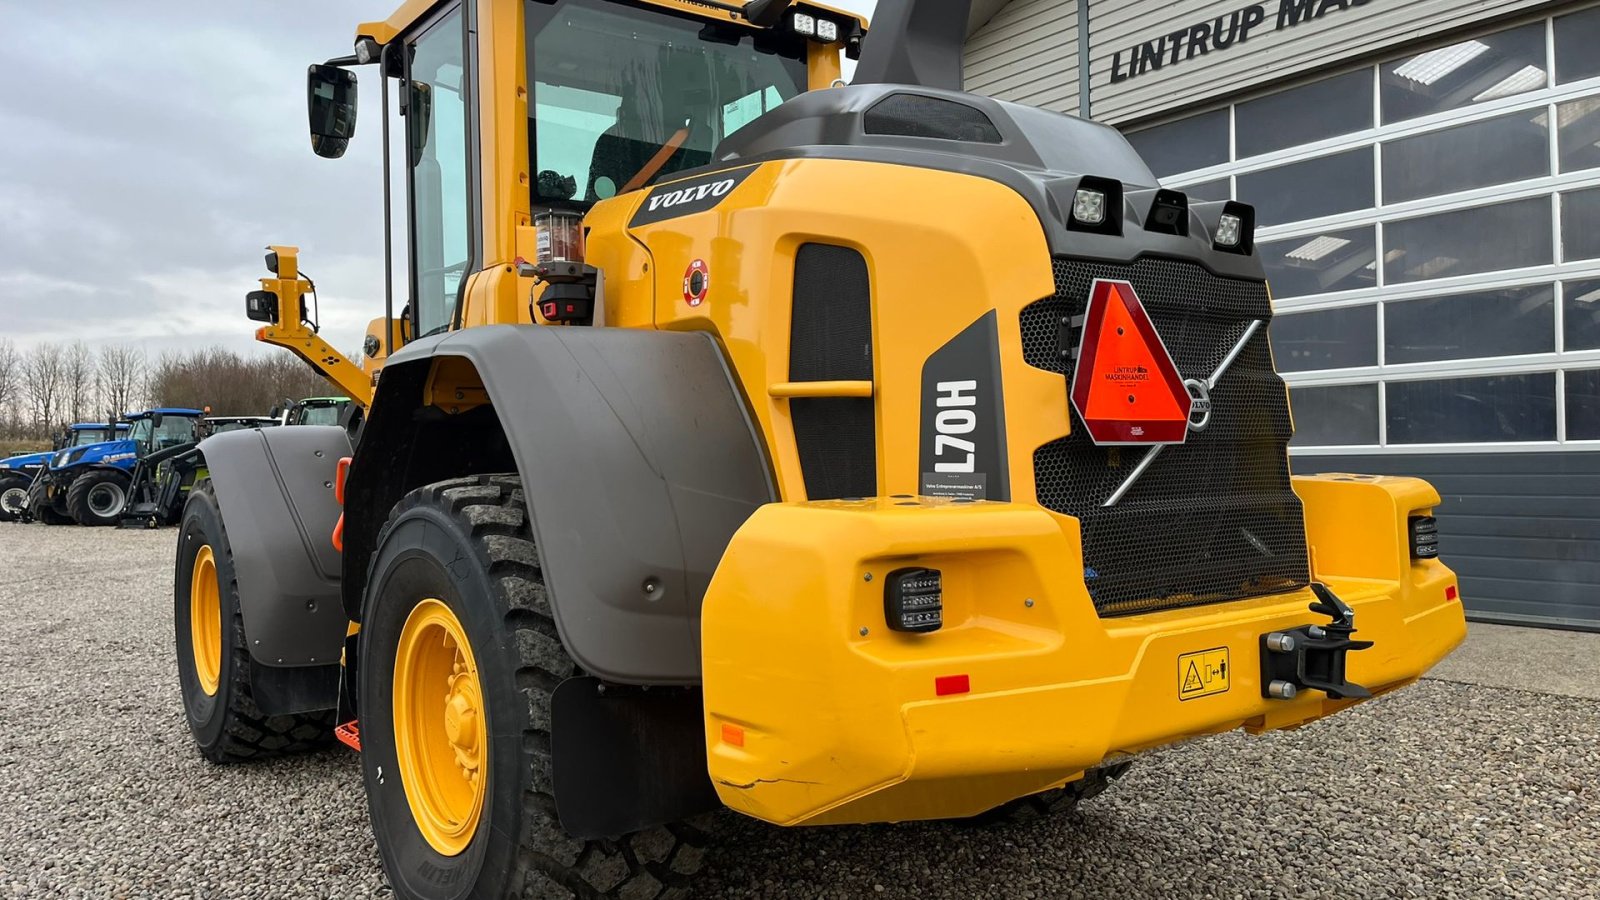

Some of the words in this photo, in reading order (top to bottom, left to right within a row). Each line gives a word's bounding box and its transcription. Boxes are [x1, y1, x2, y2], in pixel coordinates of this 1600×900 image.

[1110, 4, 1265, 84] LINTRUP
[648, 178, 735, 212] VOLVO
[1104, 373, 1150, 381] MASKINHANDEL
[1113, 366, 1138, 374] LINTRUP
[934, 379, 977, 473] L70H
